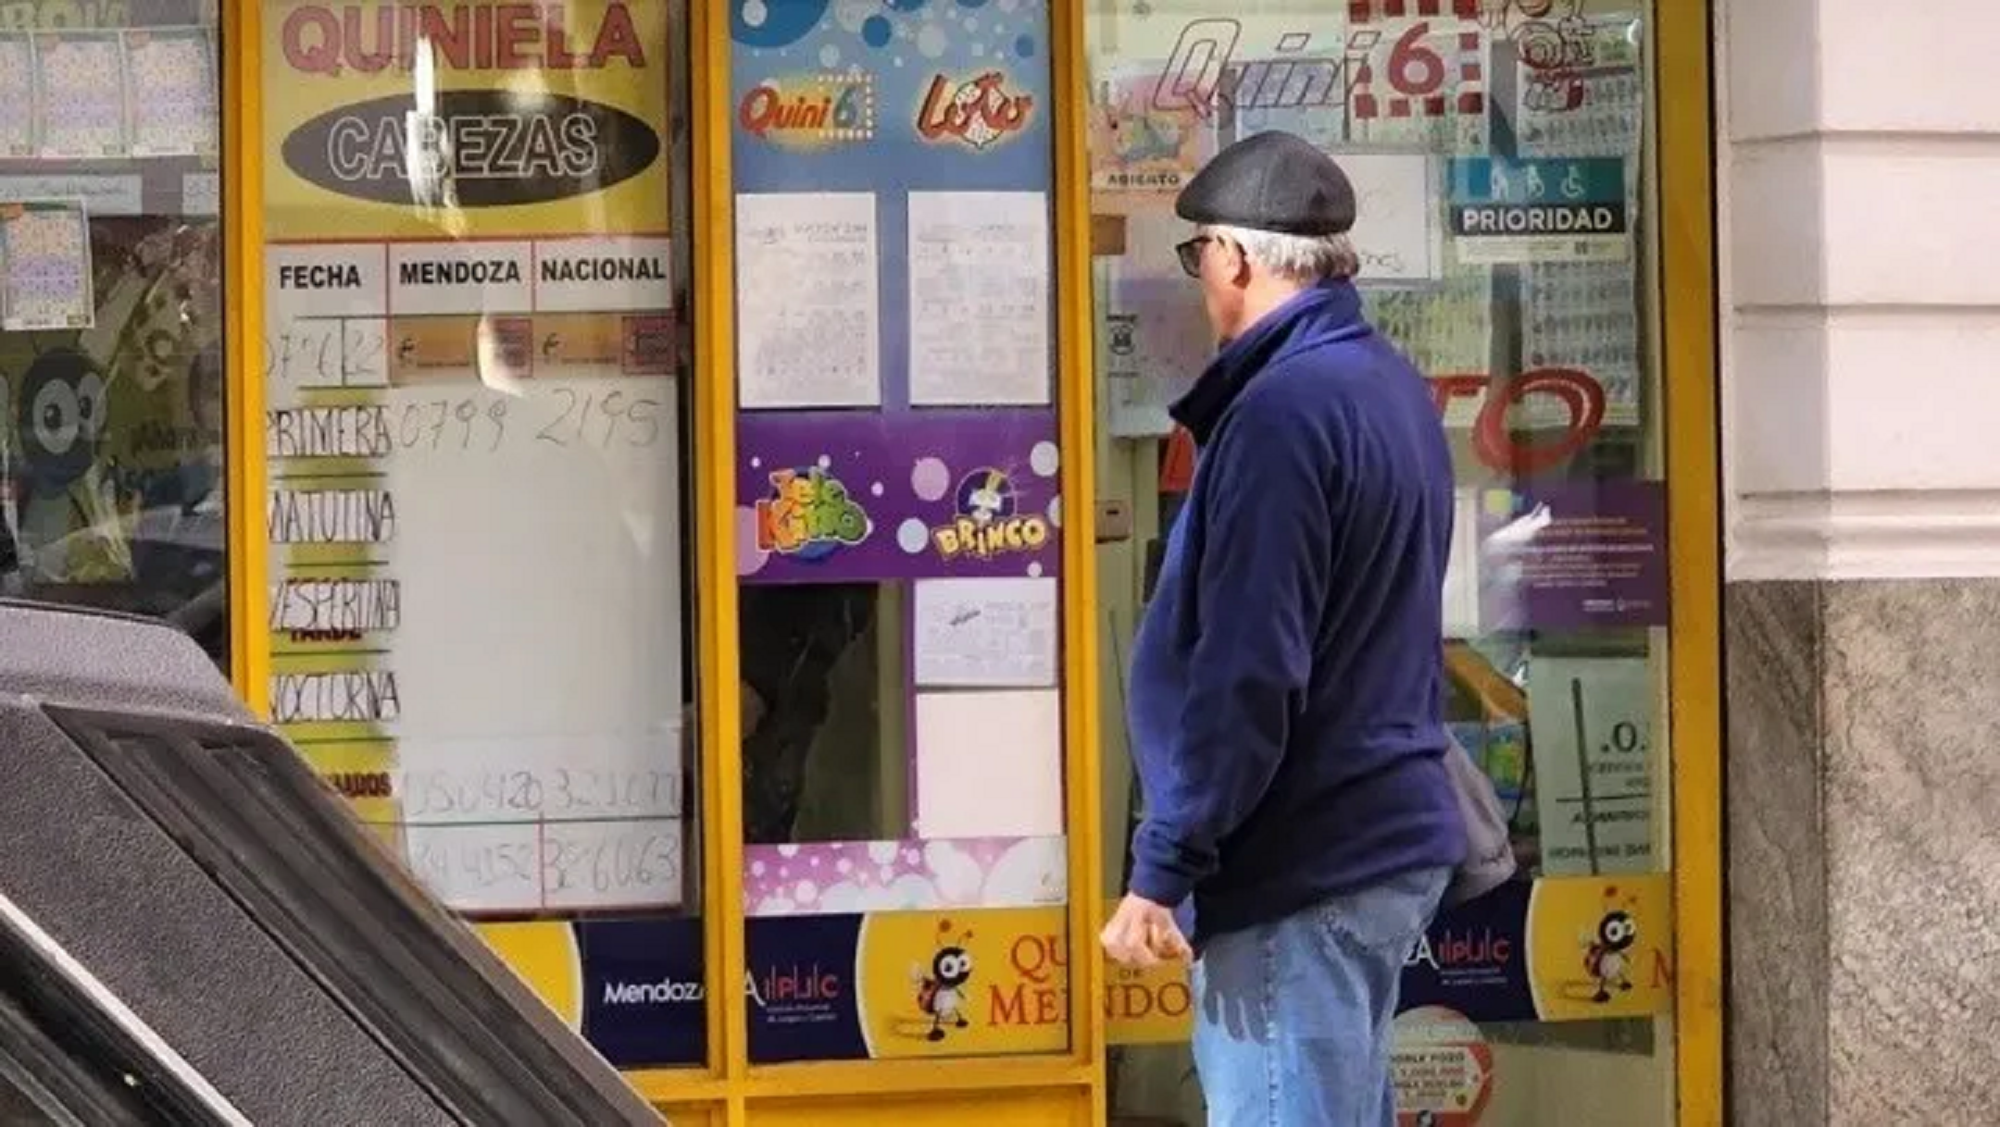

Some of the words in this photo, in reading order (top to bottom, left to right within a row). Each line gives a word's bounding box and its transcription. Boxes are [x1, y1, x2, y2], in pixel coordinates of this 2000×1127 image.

[281, 3, 646, 74] QUINIELA
[1387, 22, 1445, 96] 6
[740, 85, 831, 138] Quini
[832, 86, 858, 128] 6
[327, 114, 600, 181] CABEZAS
[1462, 207, 1613, 231] PRIORIDAD
[280, 264, 361, 289] FECHA
[400, 261, 521, 284] MENDOZA
[541, 257, 666, 282] NACIONAL
